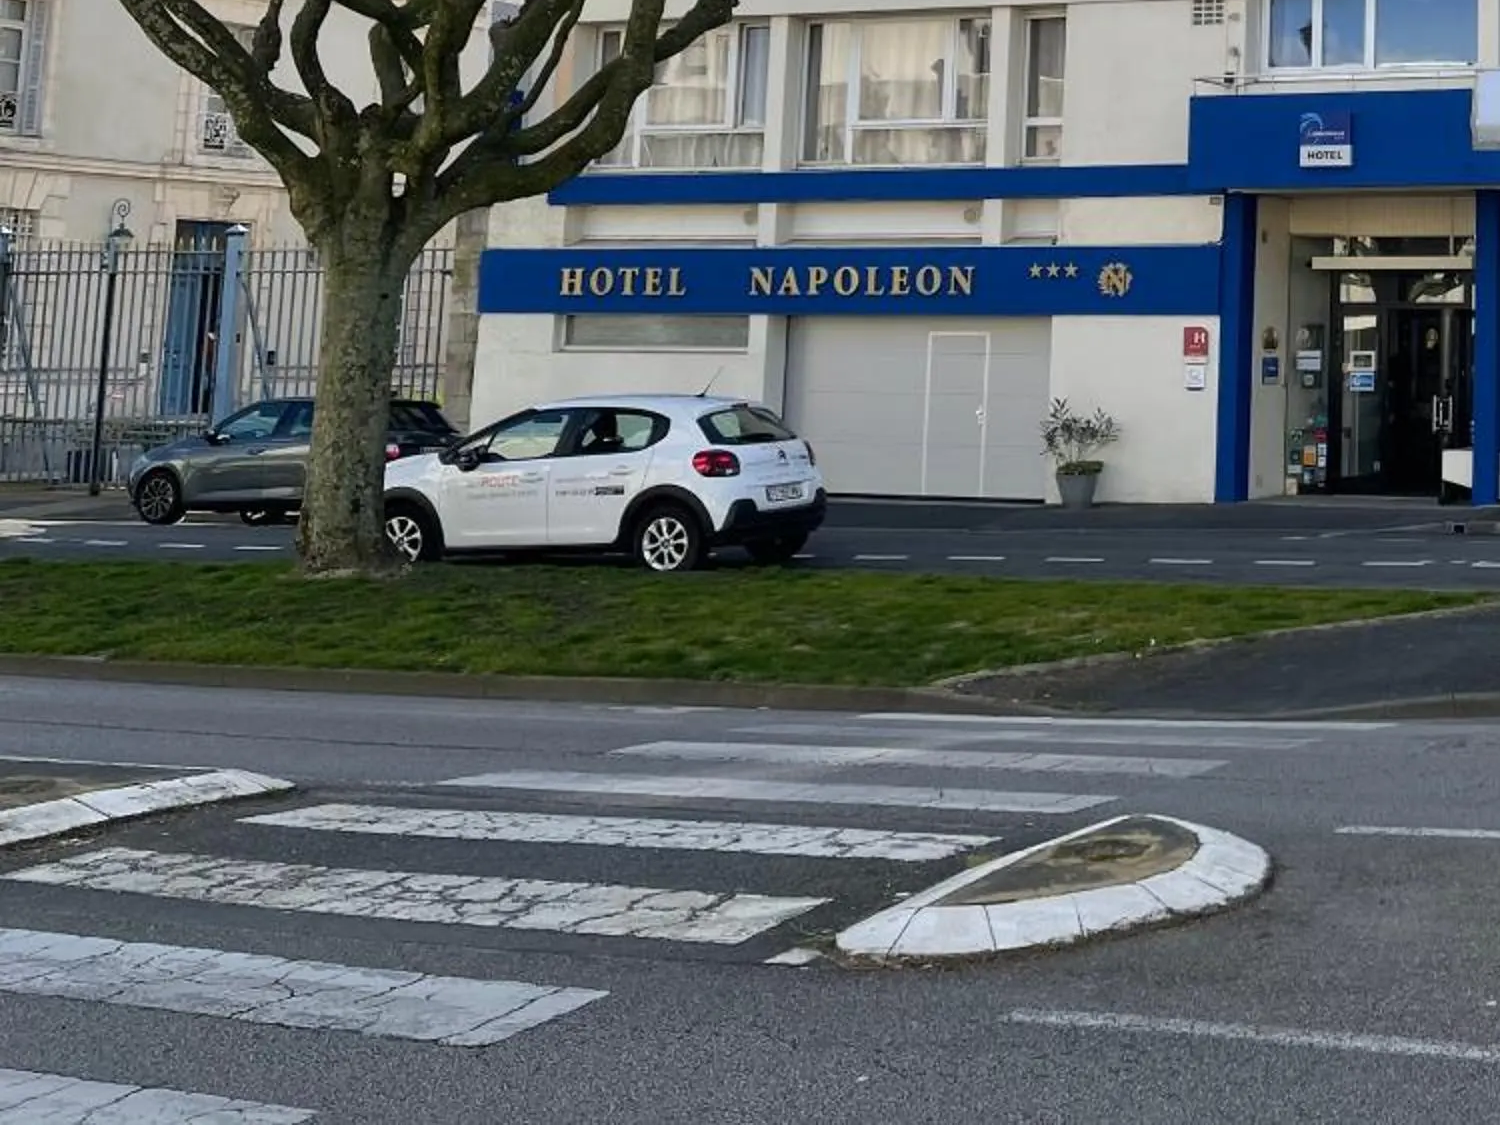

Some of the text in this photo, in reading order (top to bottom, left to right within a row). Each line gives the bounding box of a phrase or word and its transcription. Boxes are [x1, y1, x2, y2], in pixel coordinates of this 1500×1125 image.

[1307, 150, 1343, 160] HOTEL
[559, 266, 687, 296] HOTEL
[749, 265, 975, 296] NAPOLEON
